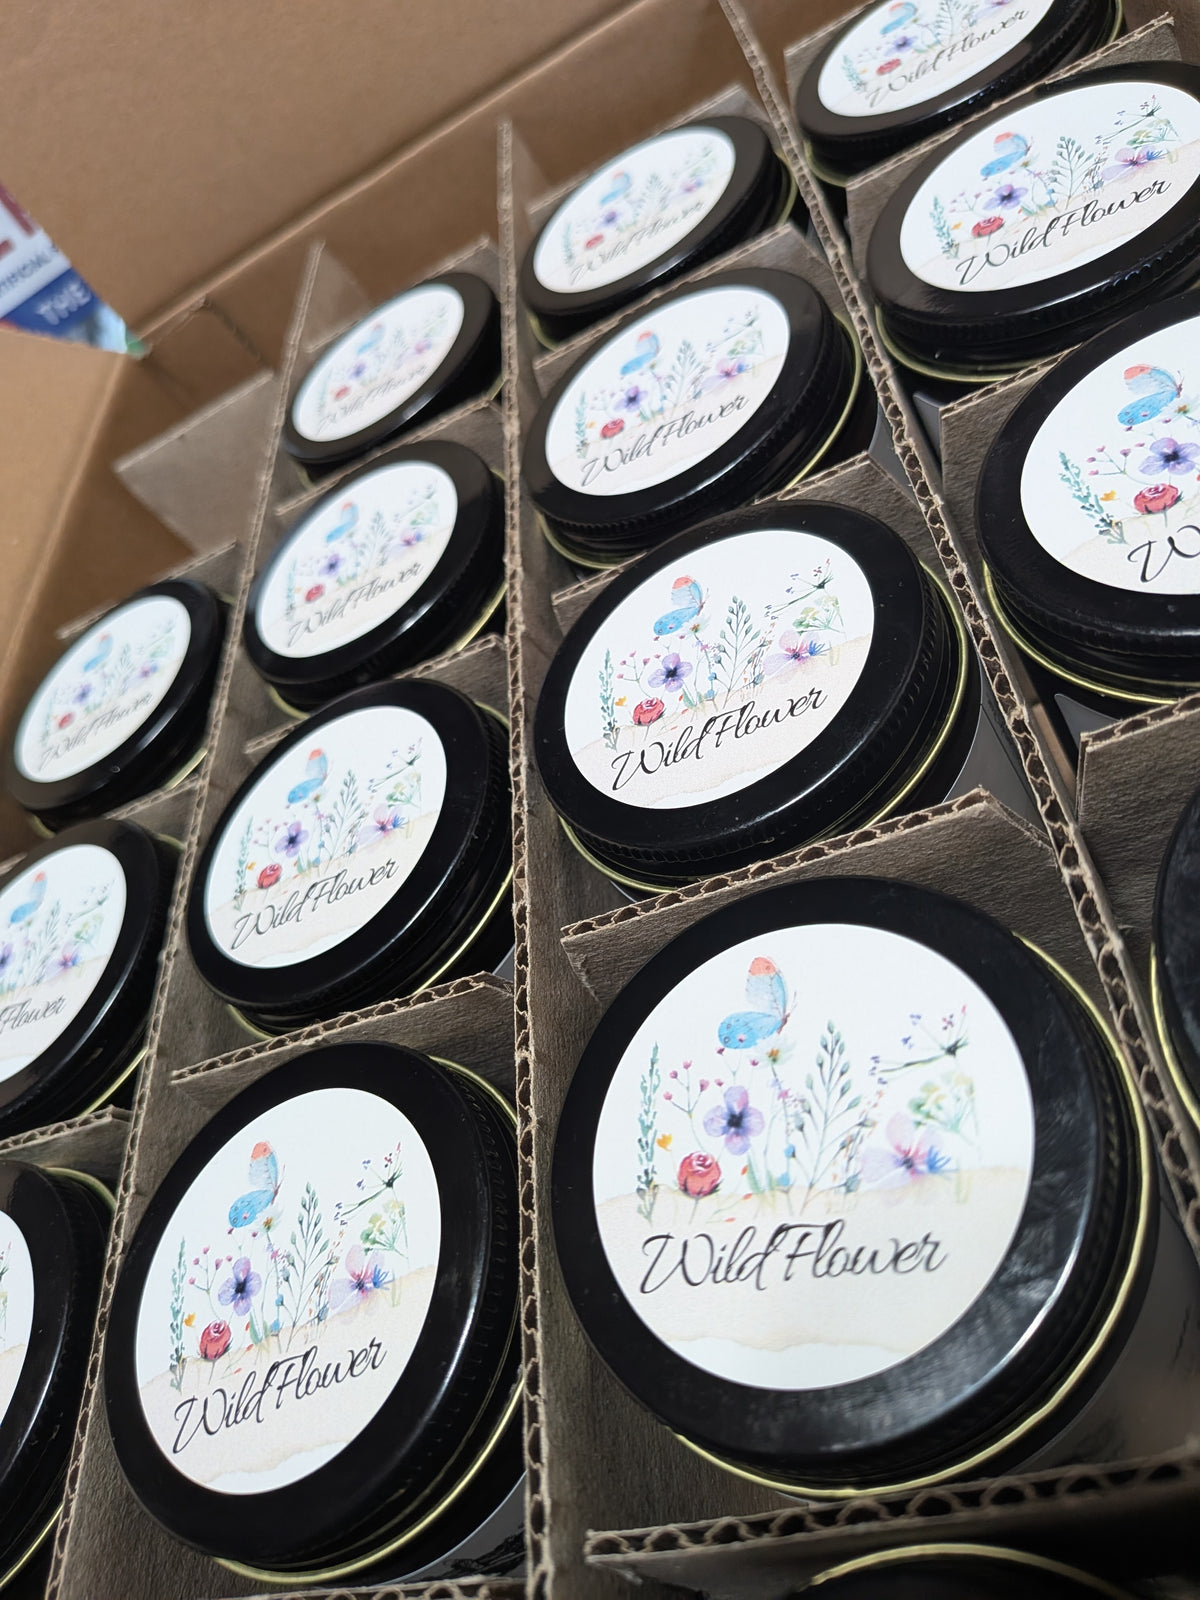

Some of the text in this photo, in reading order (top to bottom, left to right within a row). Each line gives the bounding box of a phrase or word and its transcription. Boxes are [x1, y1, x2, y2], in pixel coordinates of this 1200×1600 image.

[942, 9, 1028, 61] Flower
[955, 178, 1172, 285] Wild Flower
[581, 394, 749, 487] Wild Flower
[611, 686, 828, 791] Wild Flower
[231, 857, 400, 950] Wild Flower
[640, 1218, 948, 1294] Wild Flower
[173, 1336, 388, 1454] Wild Flower
